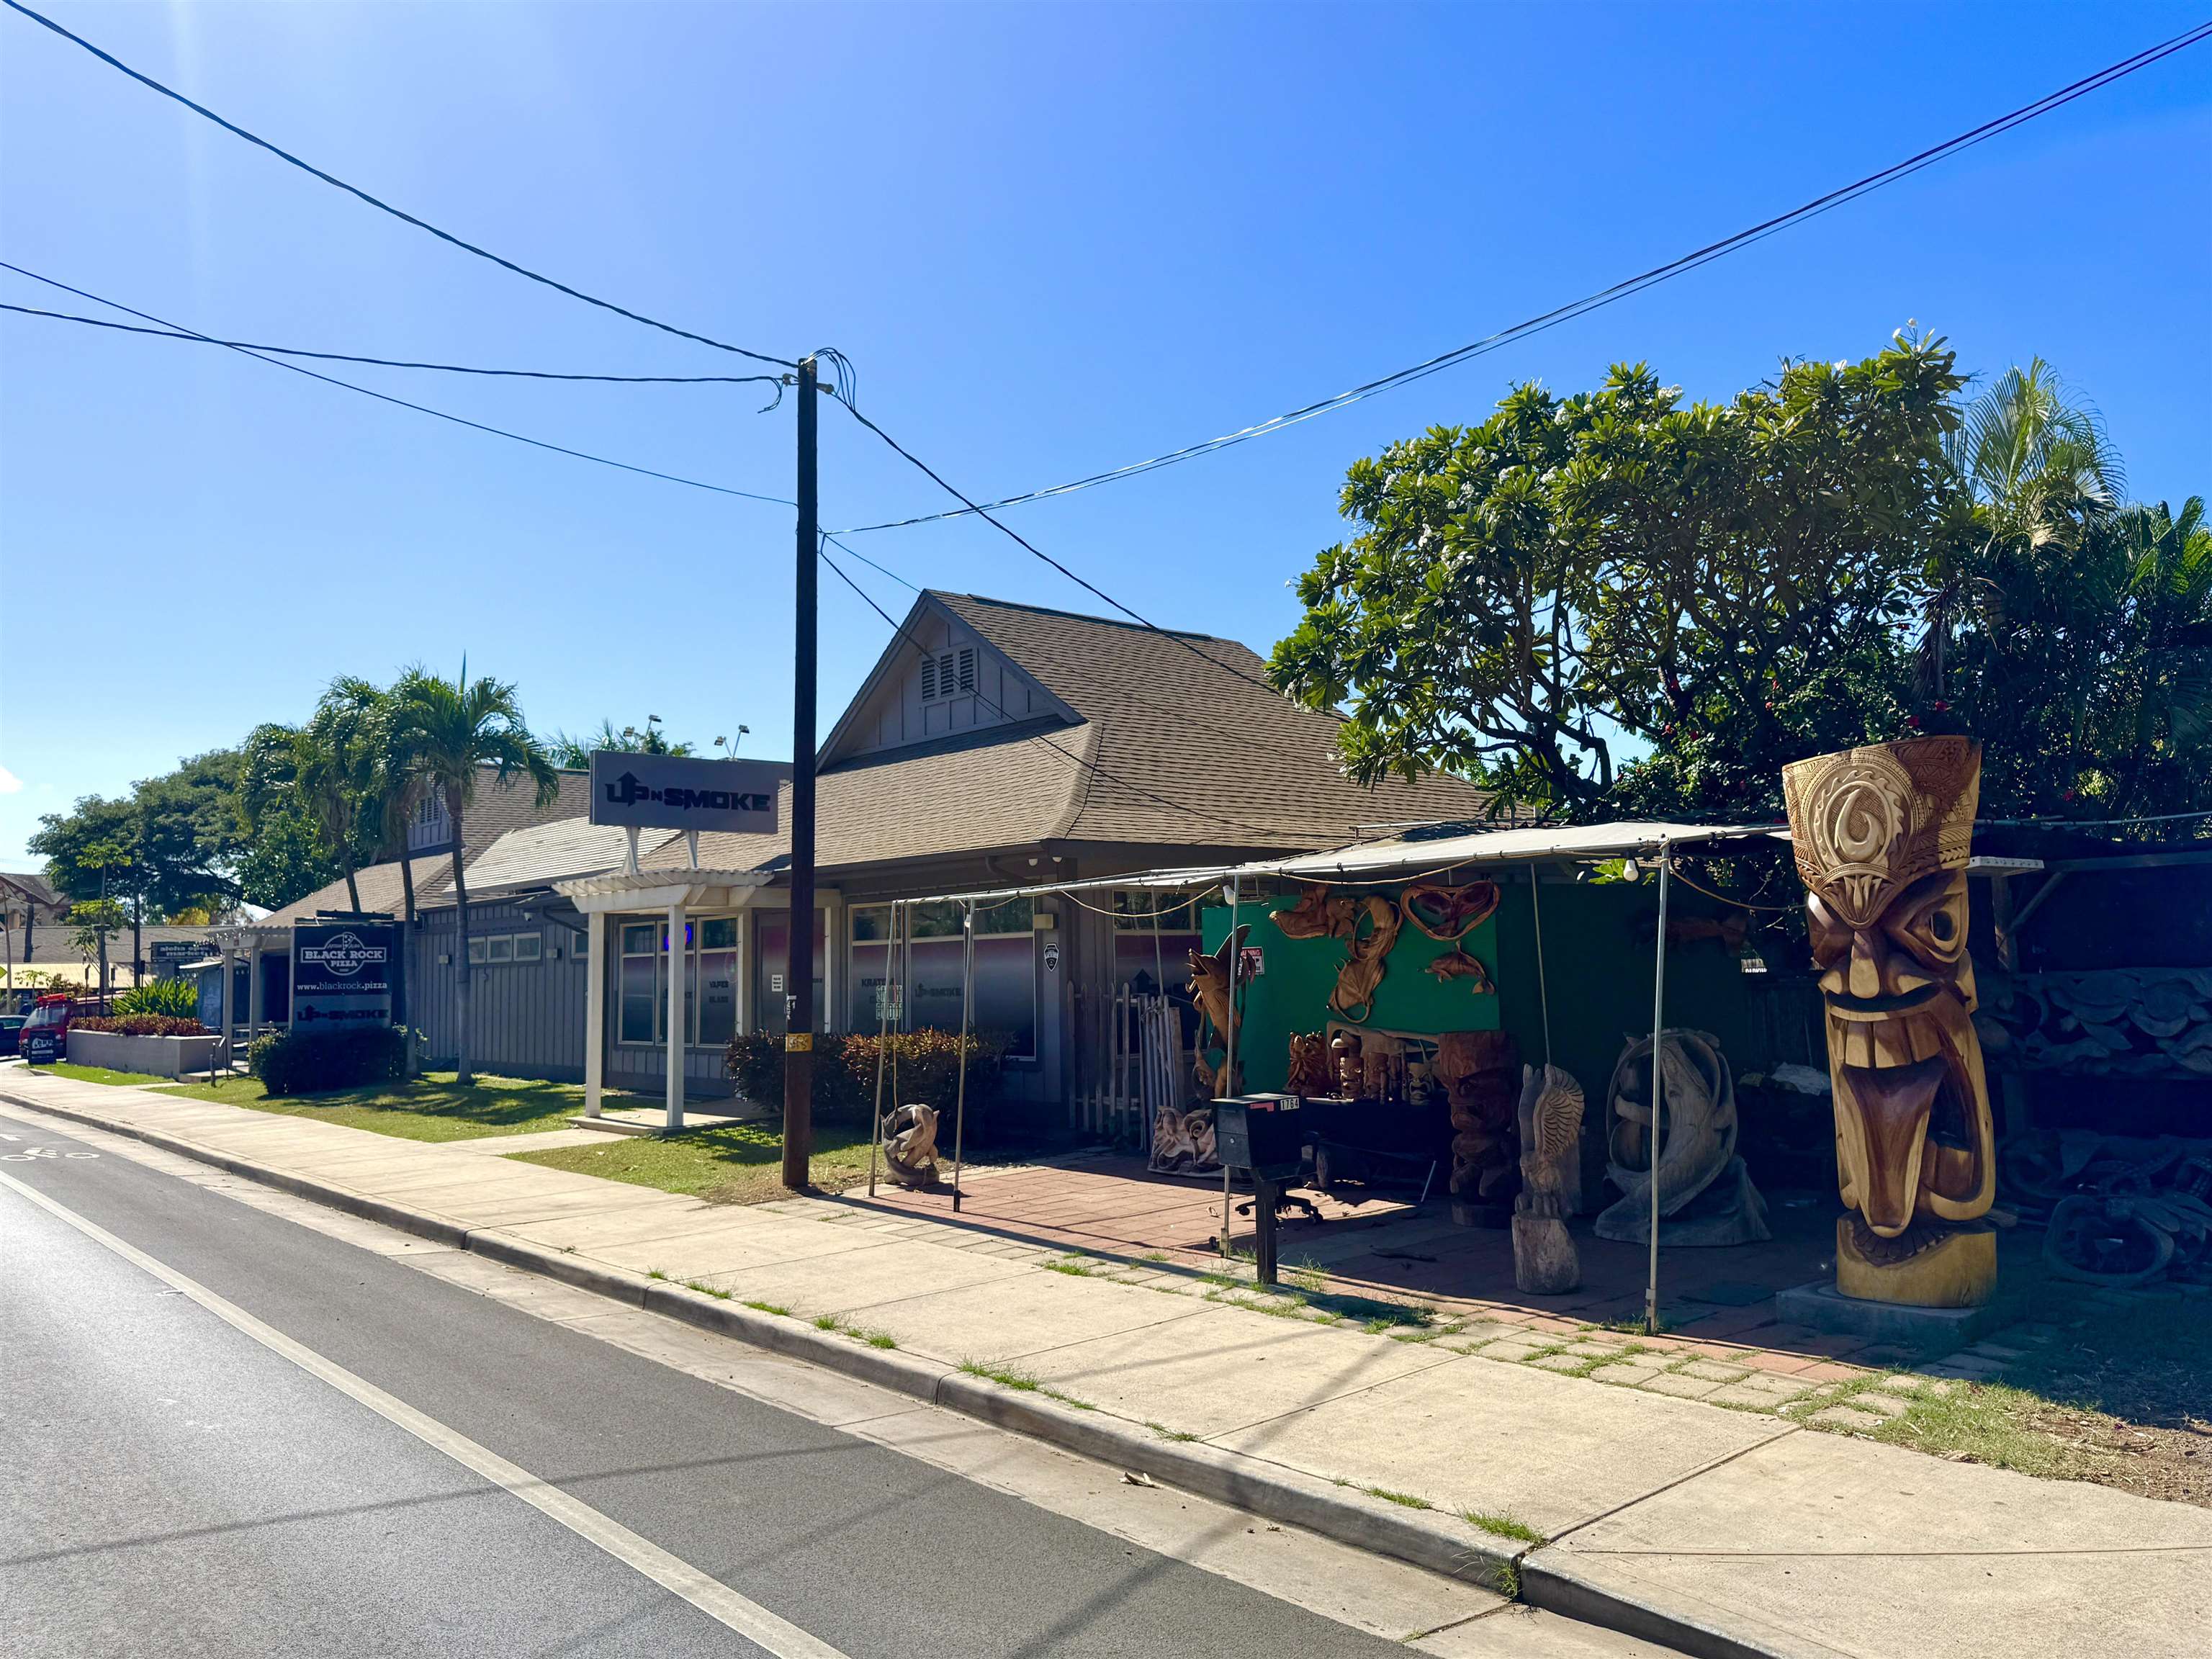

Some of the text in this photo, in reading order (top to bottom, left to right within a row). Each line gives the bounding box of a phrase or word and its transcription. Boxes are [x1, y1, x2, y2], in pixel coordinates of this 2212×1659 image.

[606, 771, 649, 806] UP
[663, 787, 770, 811] SMOKE
[305, 950, 383, 959] BLACK ROCK
[297, 981, 388, 991] www.blackrock.pizza
[328, 1010, 389, 1020] SMOKE
[1281, 1098, 1298, 1110] 1764
